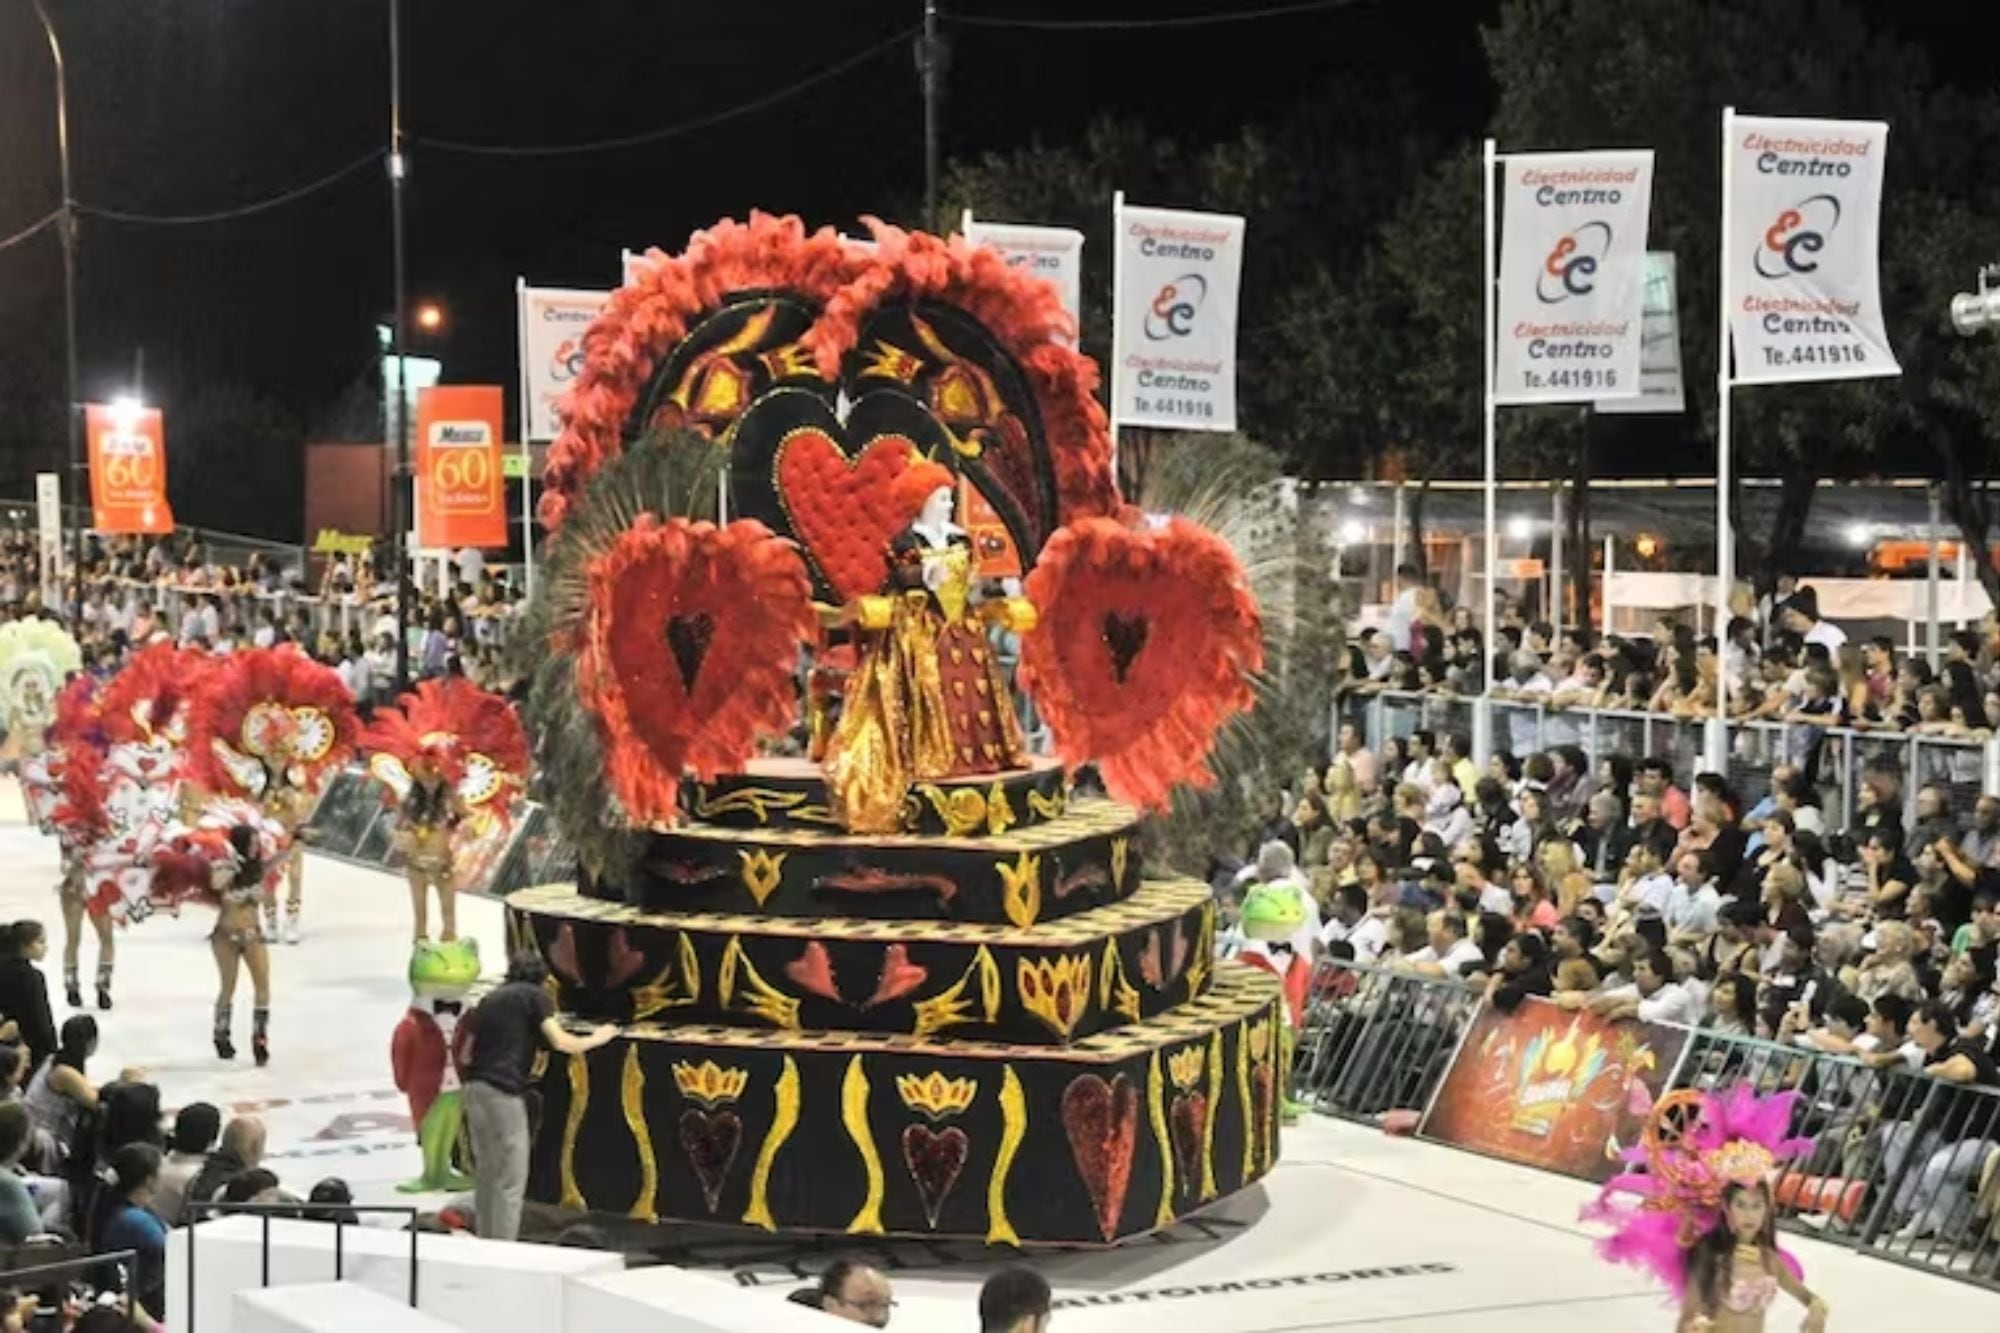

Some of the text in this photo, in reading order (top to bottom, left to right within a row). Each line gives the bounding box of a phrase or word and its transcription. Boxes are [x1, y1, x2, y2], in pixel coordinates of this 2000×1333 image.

[1743, 133, 1872, 156] Electricidad
[1757, 152, 1851, 178] Centro
[1520, 167, 1638, 186] Electricidad
[1535, 185, 1621, 207] Centro
[1140, 237, 1214, 261] Centro
[1513, 320, 1630, 338] Electricidad
[1528, 339, 1613, 359] Centro
[1763, 344, 1867, 366] Te.441916
[1137, 369, 1211, 392] Centro
[1523, 369, 1617, 389] Te.441916
[436, 449, 487, 489] 60
